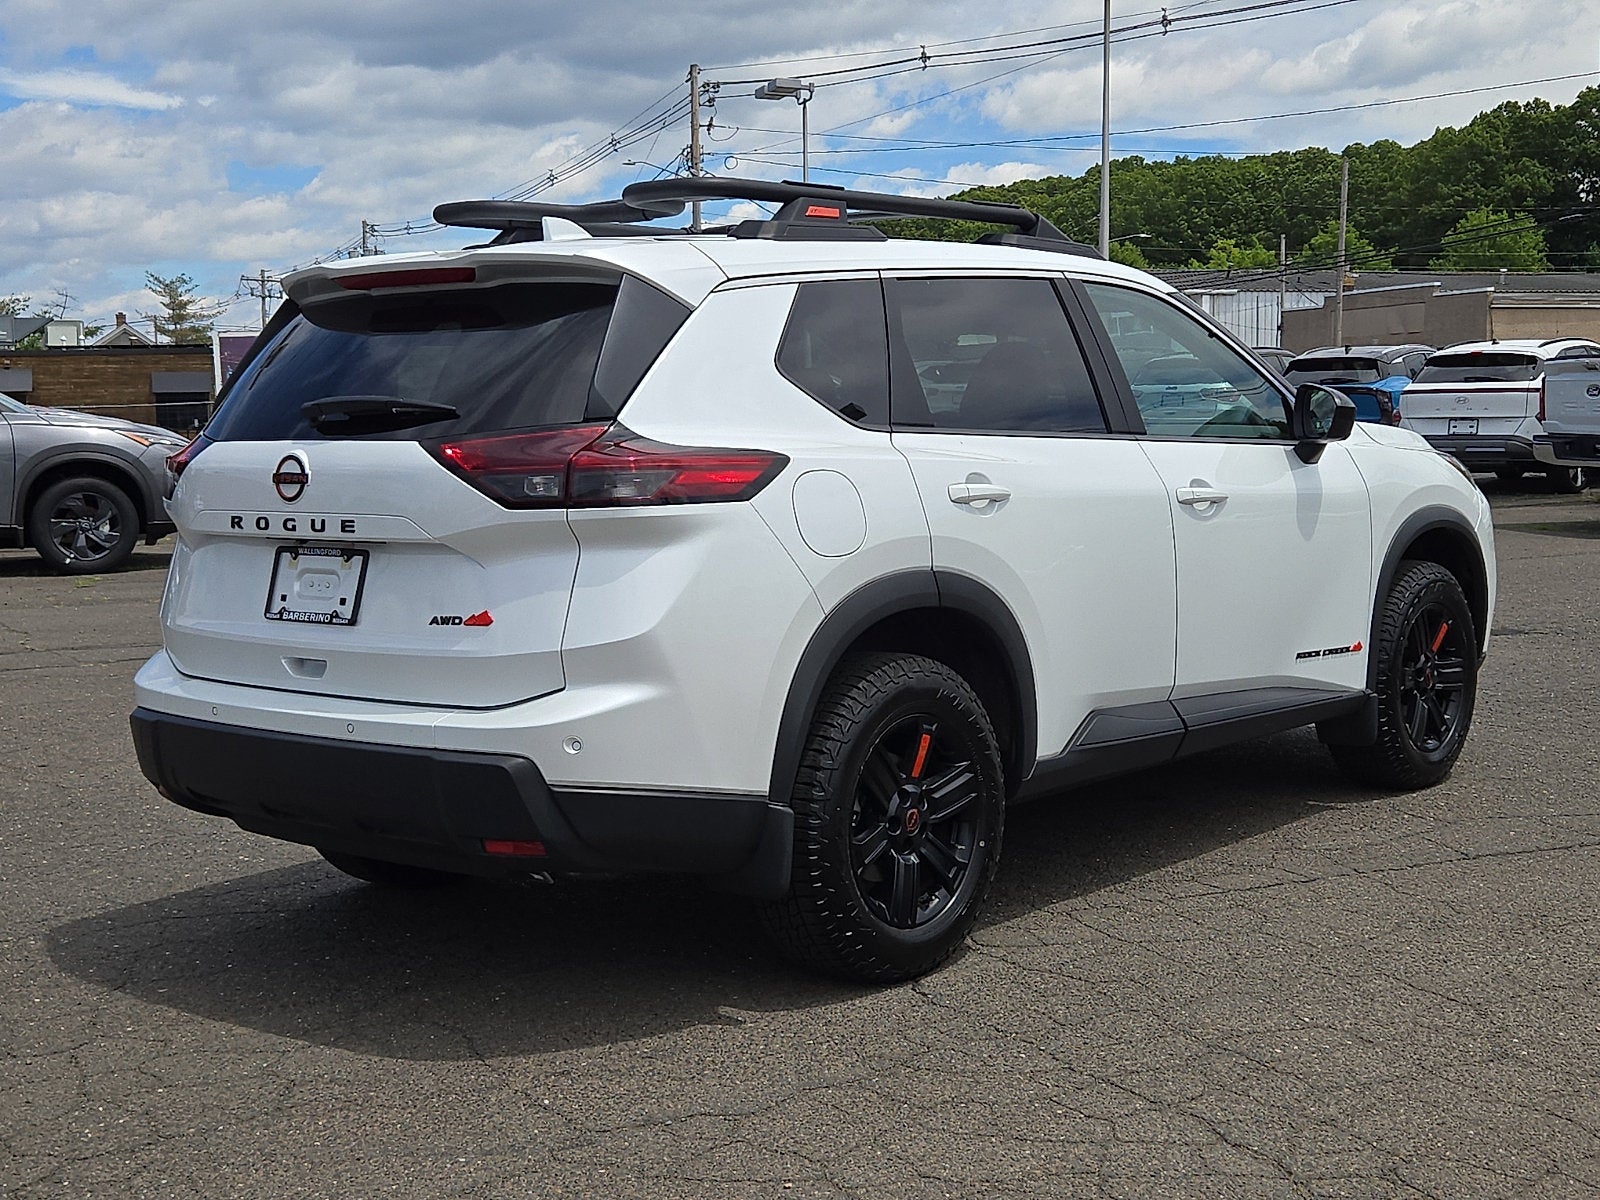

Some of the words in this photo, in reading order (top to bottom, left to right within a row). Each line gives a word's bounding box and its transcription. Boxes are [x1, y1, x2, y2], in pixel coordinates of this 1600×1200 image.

[230, 515, 356, 533] ROGUE
[297, 547, 342, 556] WALLINGFORD
[282, 611, 331, 623] BARBERINO
[428, 615, 464, 626] AWD
